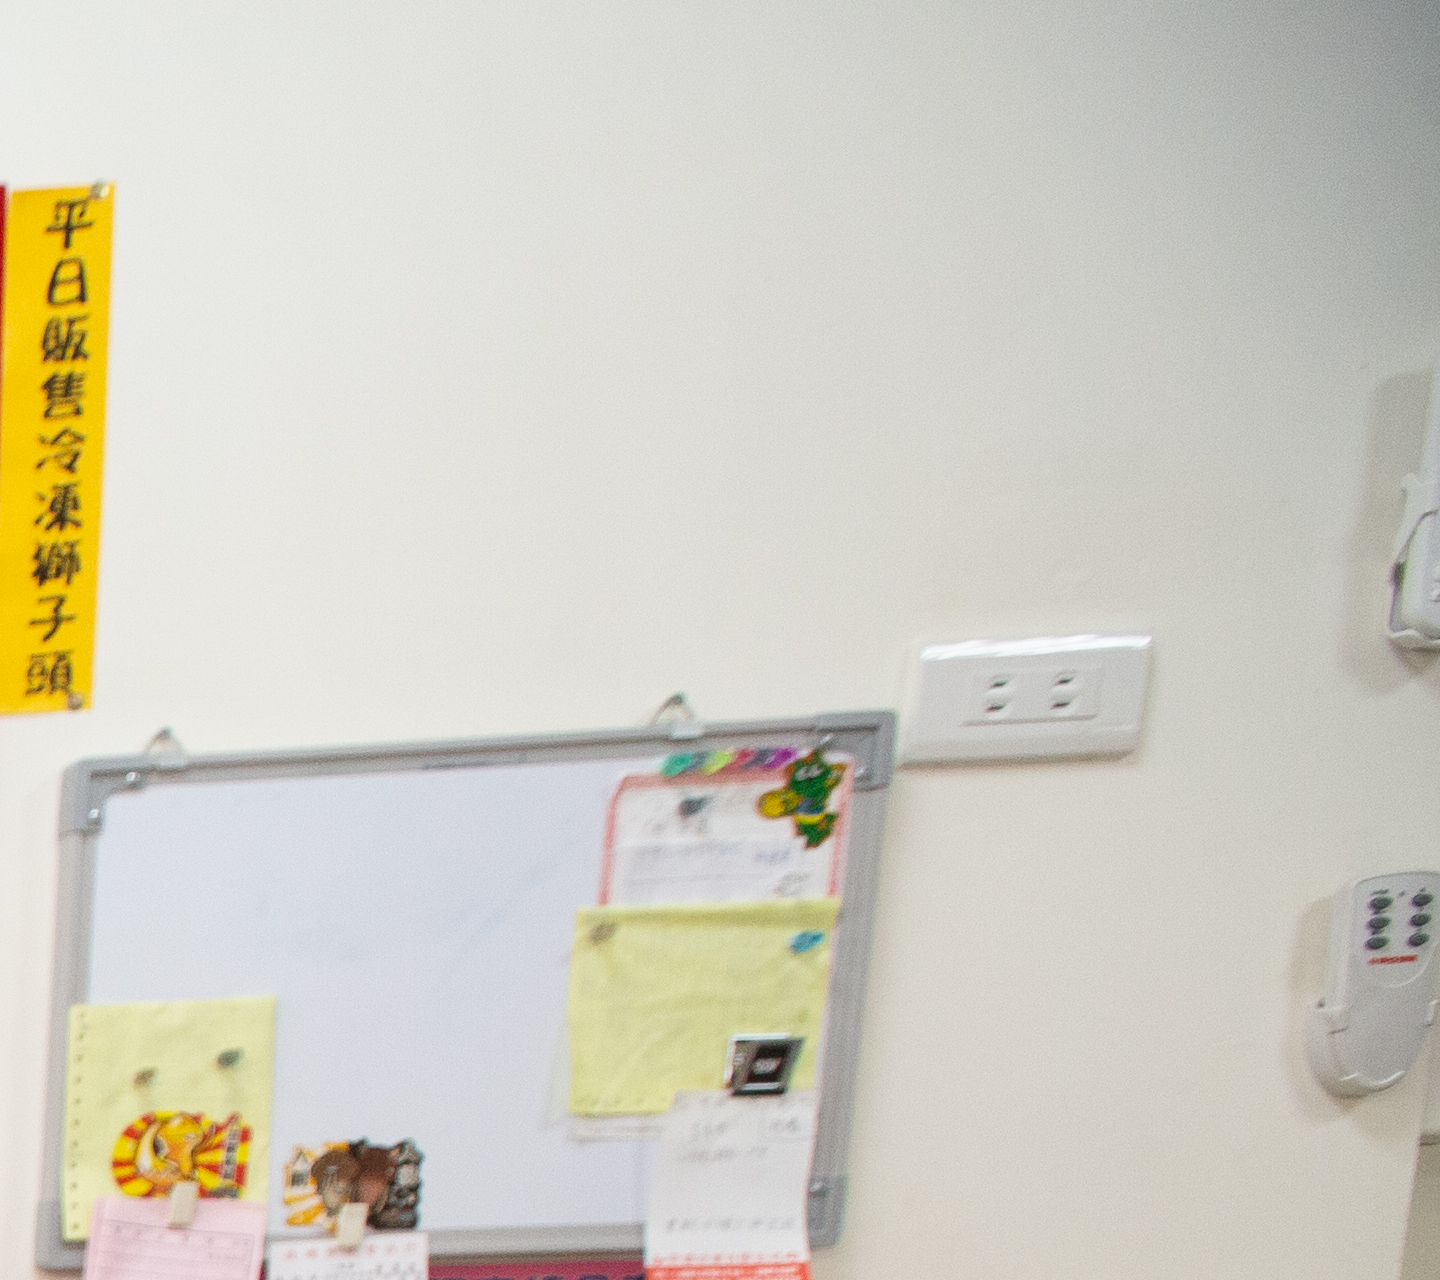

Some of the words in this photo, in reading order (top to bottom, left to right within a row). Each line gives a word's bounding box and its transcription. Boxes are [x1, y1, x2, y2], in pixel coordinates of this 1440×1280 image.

[25, 199, 94, 697] 平日販售冷凍獅子頭
